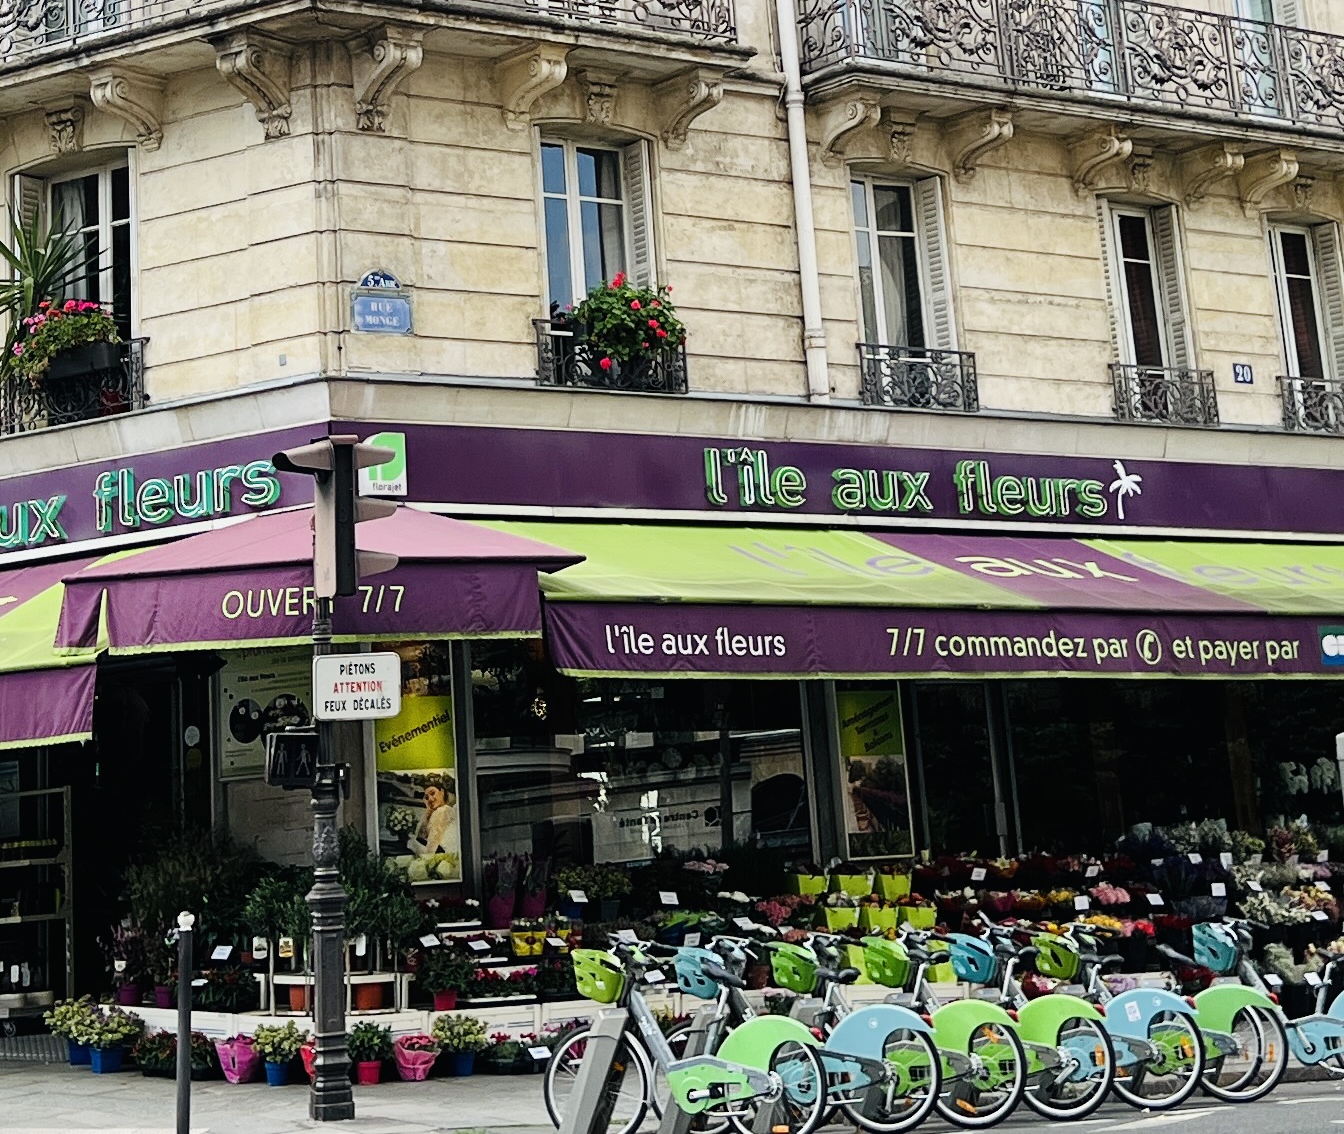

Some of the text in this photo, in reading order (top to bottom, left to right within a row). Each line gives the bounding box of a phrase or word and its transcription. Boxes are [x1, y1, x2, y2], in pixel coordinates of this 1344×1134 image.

[365, 314, 400, 326] MONGE
[370, 302, 393, 313] RUE
[1236, 365, 1251, 382] 20
[93, 460, 280, 531] fleurs
[704, 447, 1108, 519] l'île aux fleurs
[954, 556, 1140, 582] aux
[358, 585, 405, 614] 7/7
[605, 624, 786, 657] l'île aux fleurs
[886, 627, 925, 656] 7/7
[935, 630, 1088, 658] commandez
[1092, 637, 1128, 665] par
[1172, 636, 1195, 659] et
[1198, 640, 1259, 666] payer
[1265, 640, 1300, 666] par
[339, 663, 376, 675] PIÉTONS
[333, 680, 383, 694] ATTENTION
[324, 697, 392, 712] FEUX DÉCALÉS
[379, 709, 453, 754] Evénementiel
